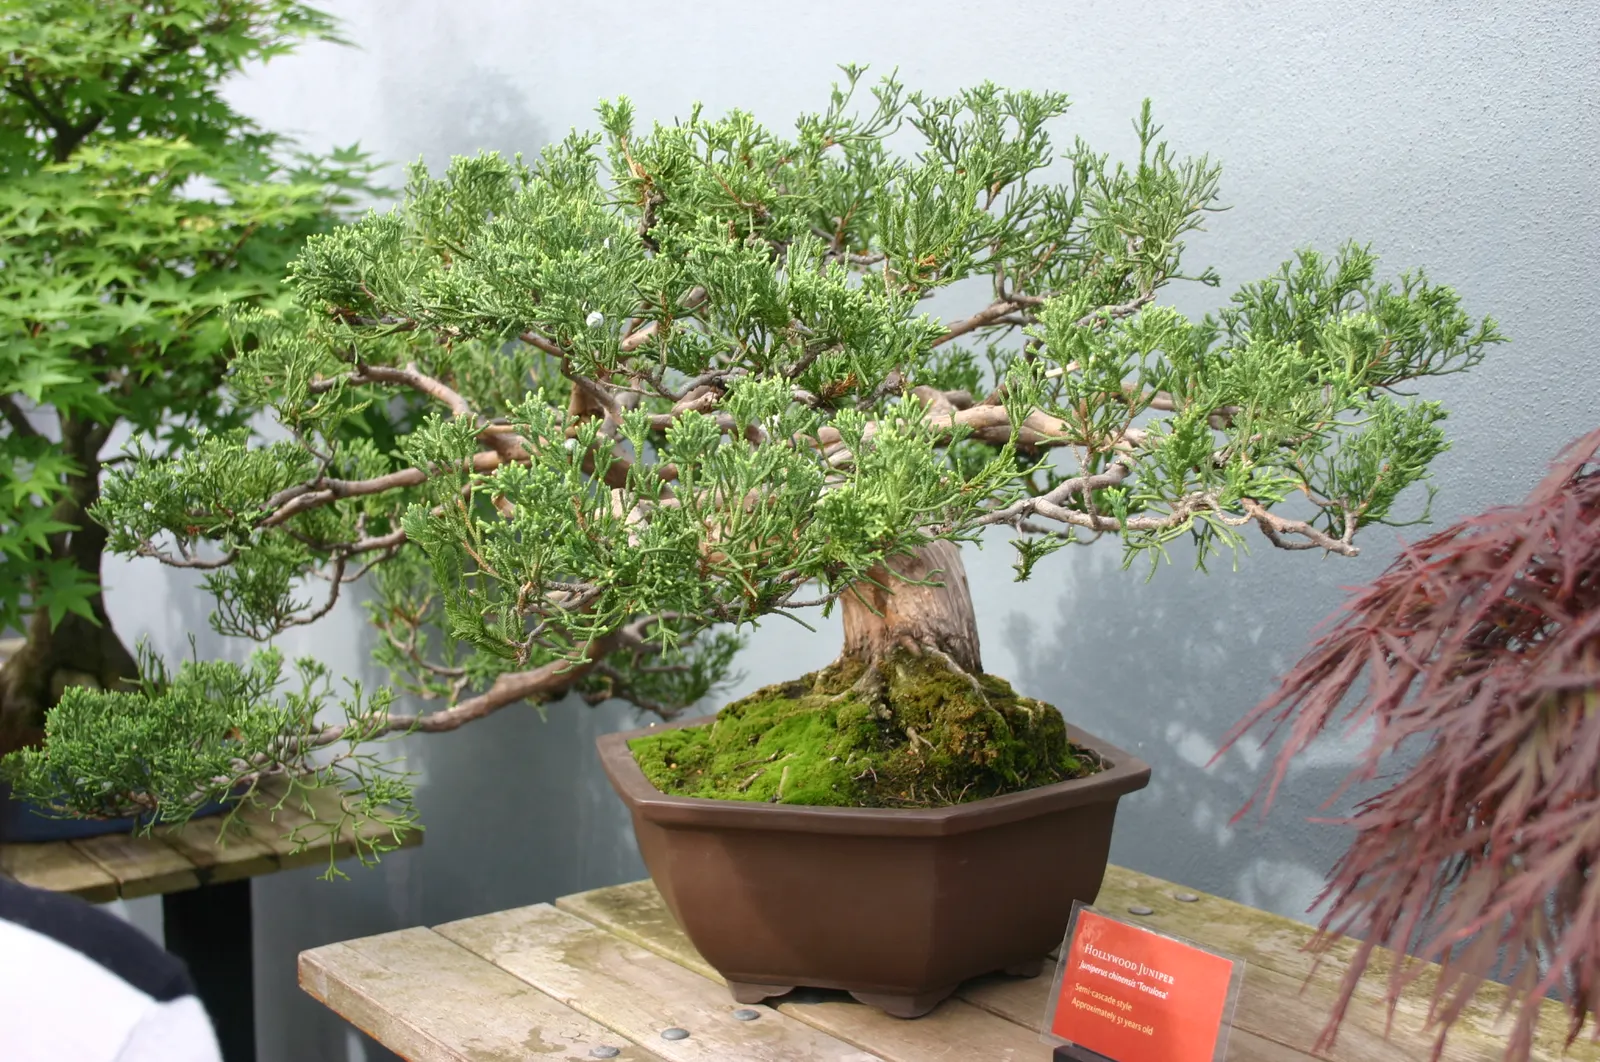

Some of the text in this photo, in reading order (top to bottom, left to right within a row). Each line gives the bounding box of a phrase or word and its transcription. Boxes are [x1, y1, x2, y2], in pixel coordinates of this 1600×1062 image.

[1079, 960, 1108, 977] Juniperus
[1108, 972, 1136, 988] chinensis
[1084, 943, 1175, 985] HOLLYWOOD JUNIPER
[1075, 983, 1133, 1012] Semi-cascade style
[1071, 997, 1117, 1022] Approximately
[1123, 1019, 1141, 1031] years
[1142, 1025, 1154, 1036] old
